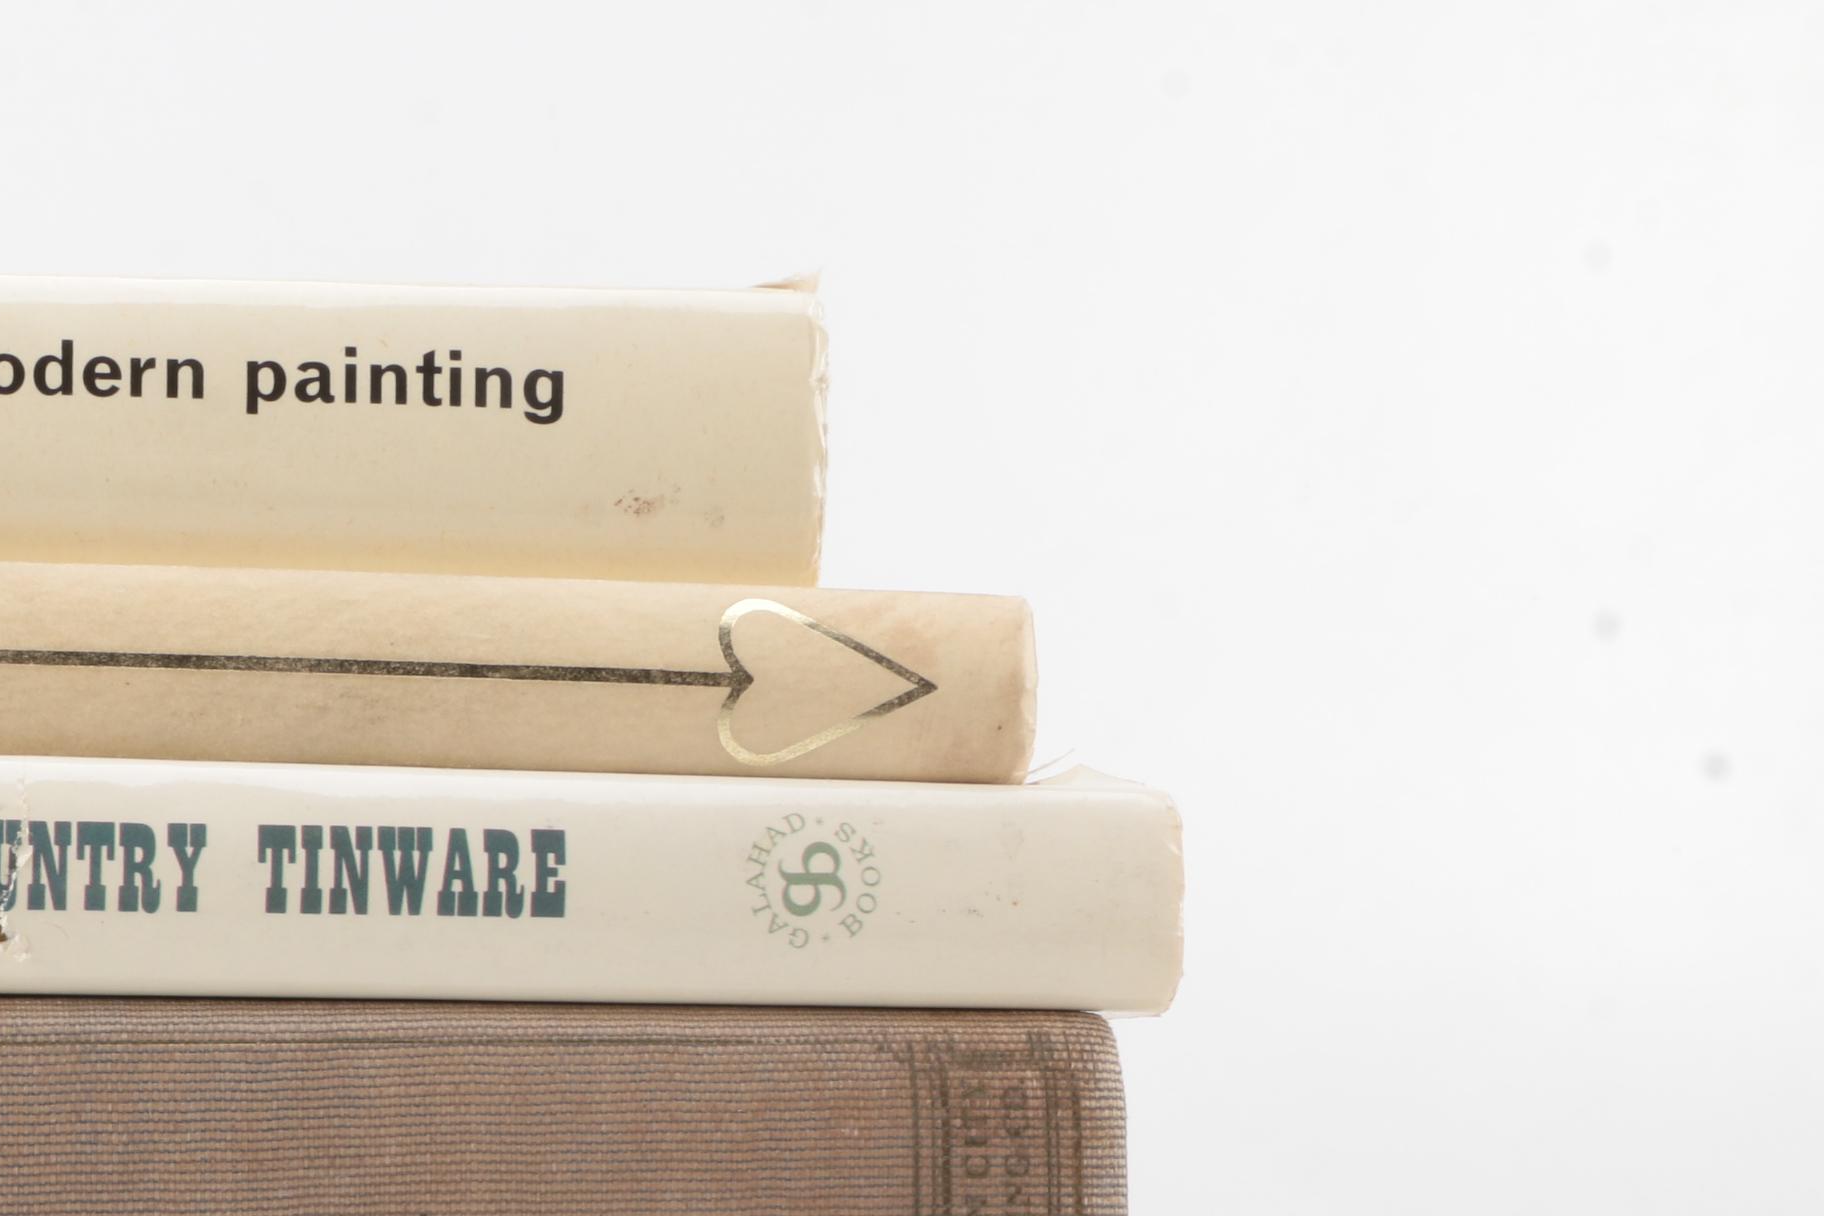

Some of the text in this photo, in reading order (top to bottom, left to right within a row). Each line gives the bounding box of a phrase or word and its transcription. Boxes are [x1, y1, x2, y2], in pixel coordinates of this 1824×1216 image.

[246, 347, 565, 424] painting
[258, 824, 566, 918] TINWARE
[745, 812, 810, 949] GALAHAD
[833, 822, 881, 938] BOOKS
